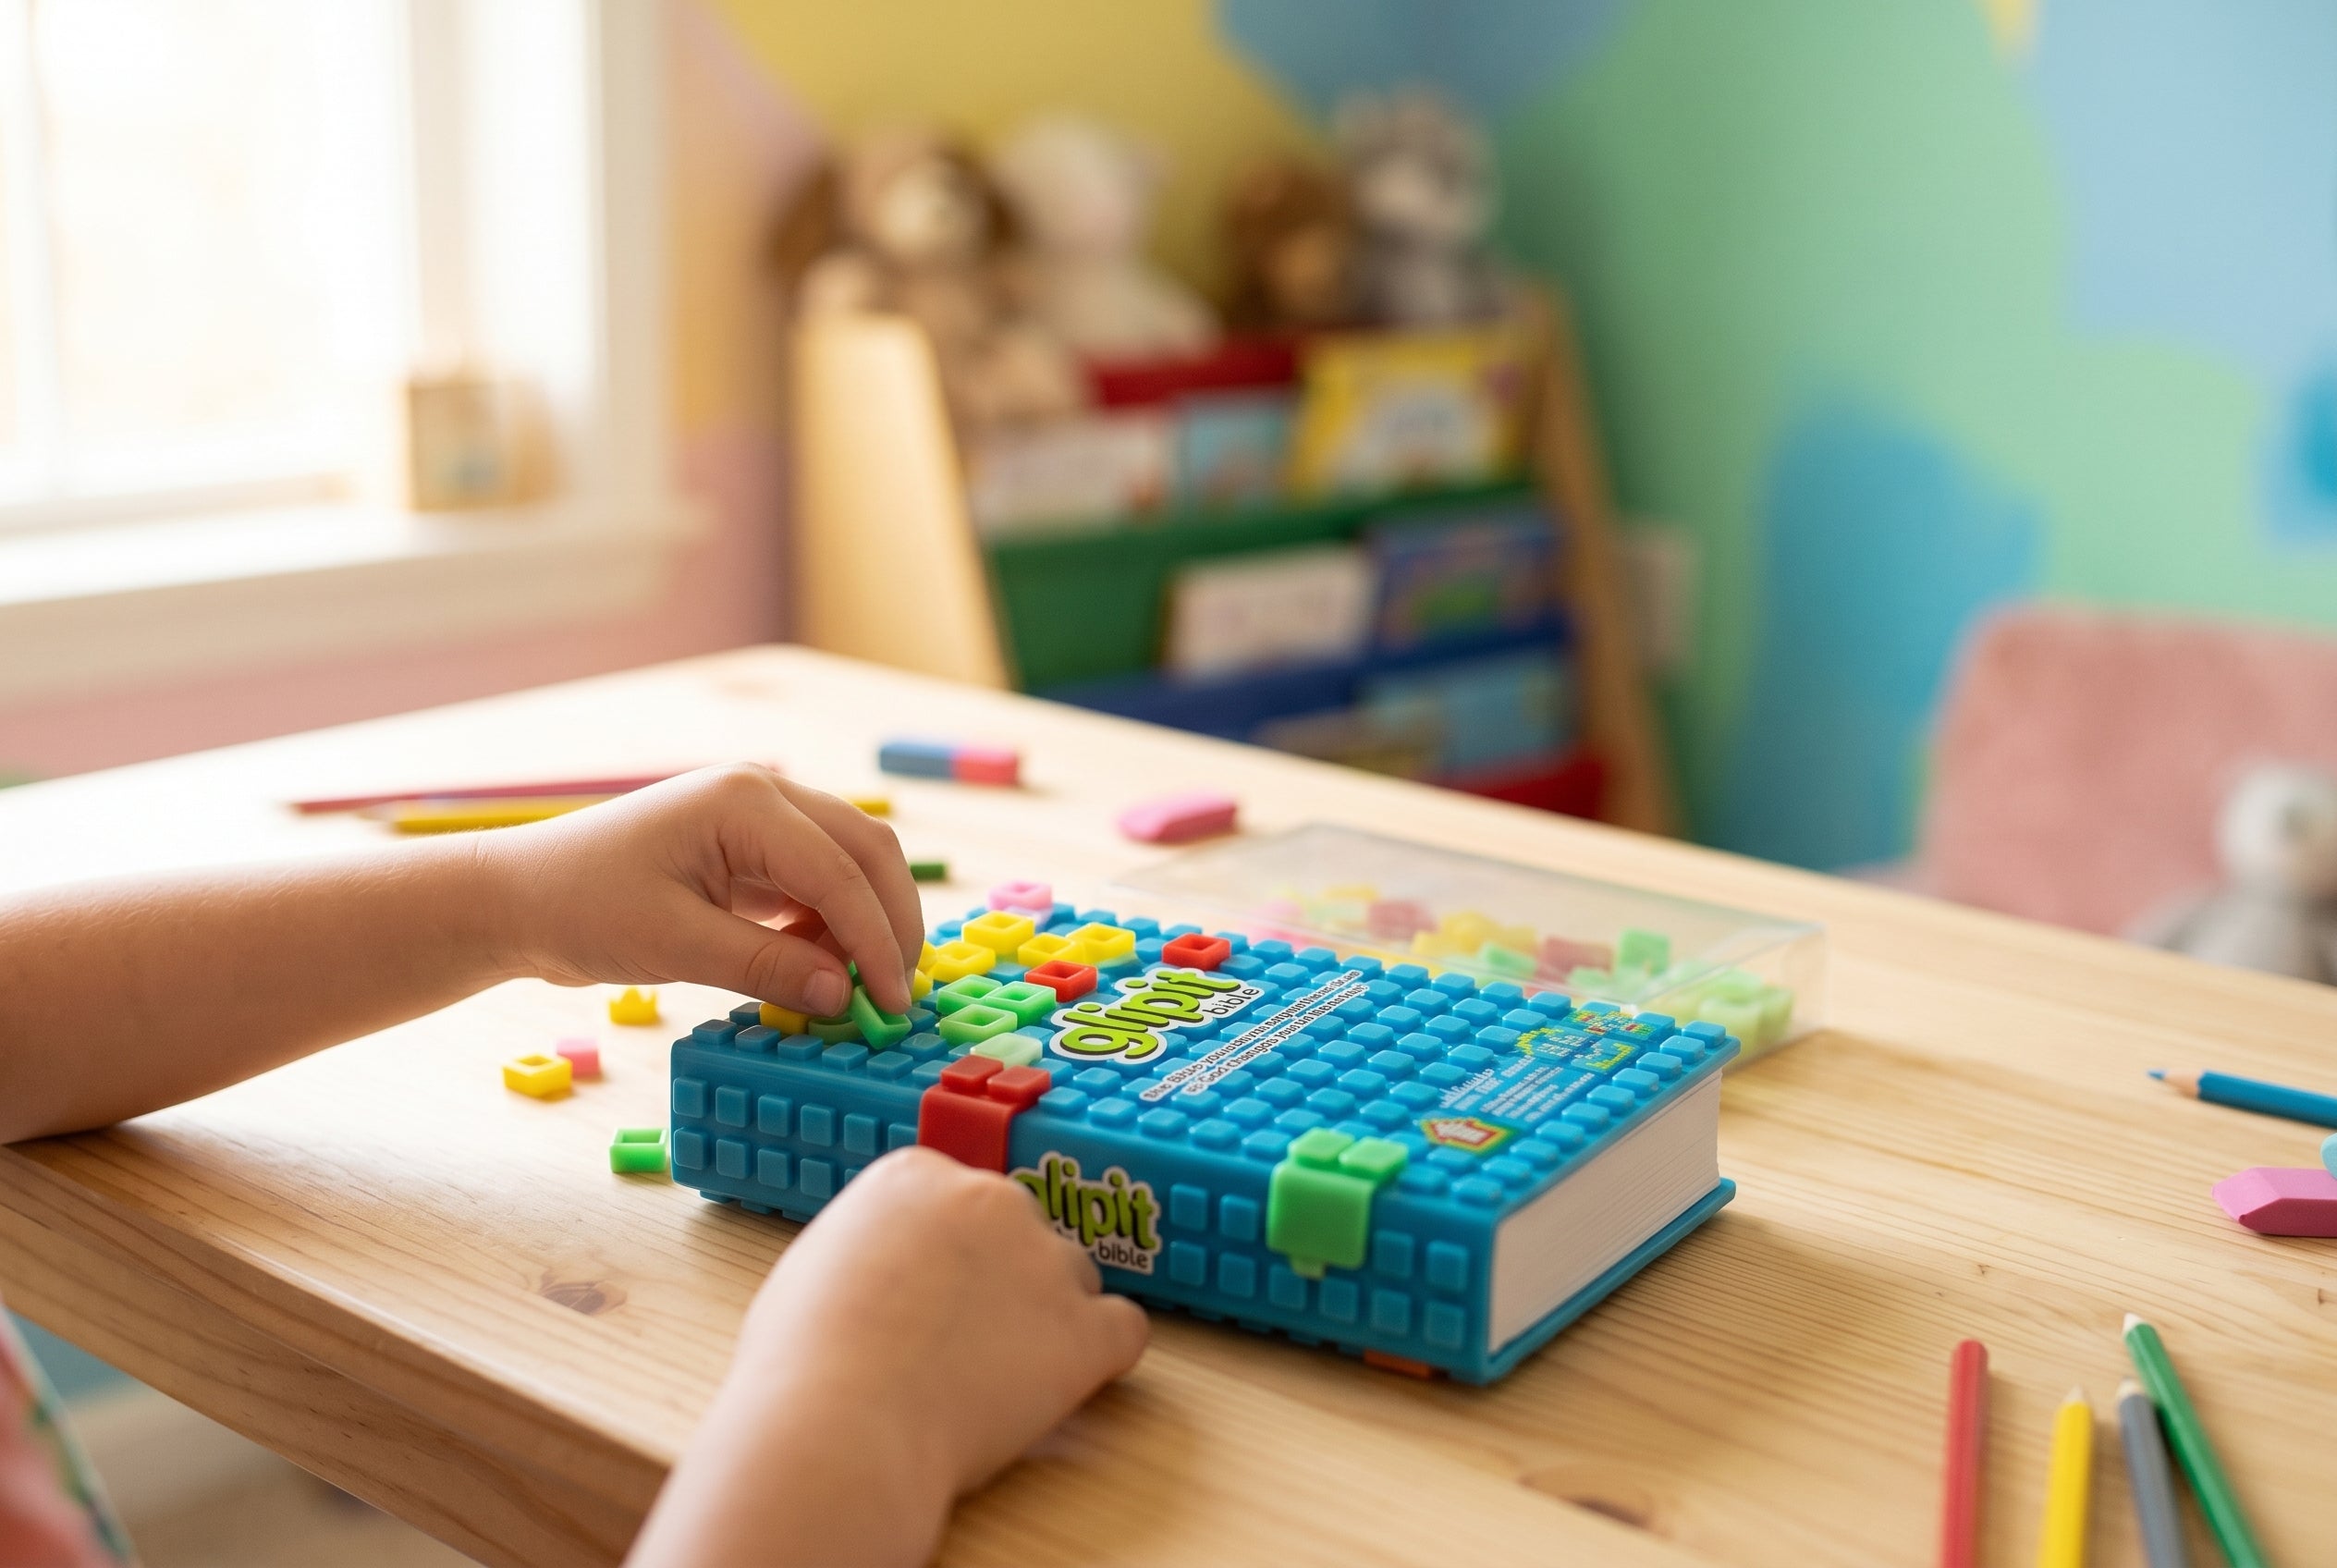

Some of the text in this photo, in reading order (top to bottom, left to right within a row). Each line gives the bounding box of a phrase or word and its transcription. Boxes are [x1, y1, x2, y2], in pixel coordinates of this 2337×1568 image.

[1059, 970, 1242, 1060] glipit
[1203, 987, 1260, 1016] bible
[1097, 1240, 1149, 1269] bible
